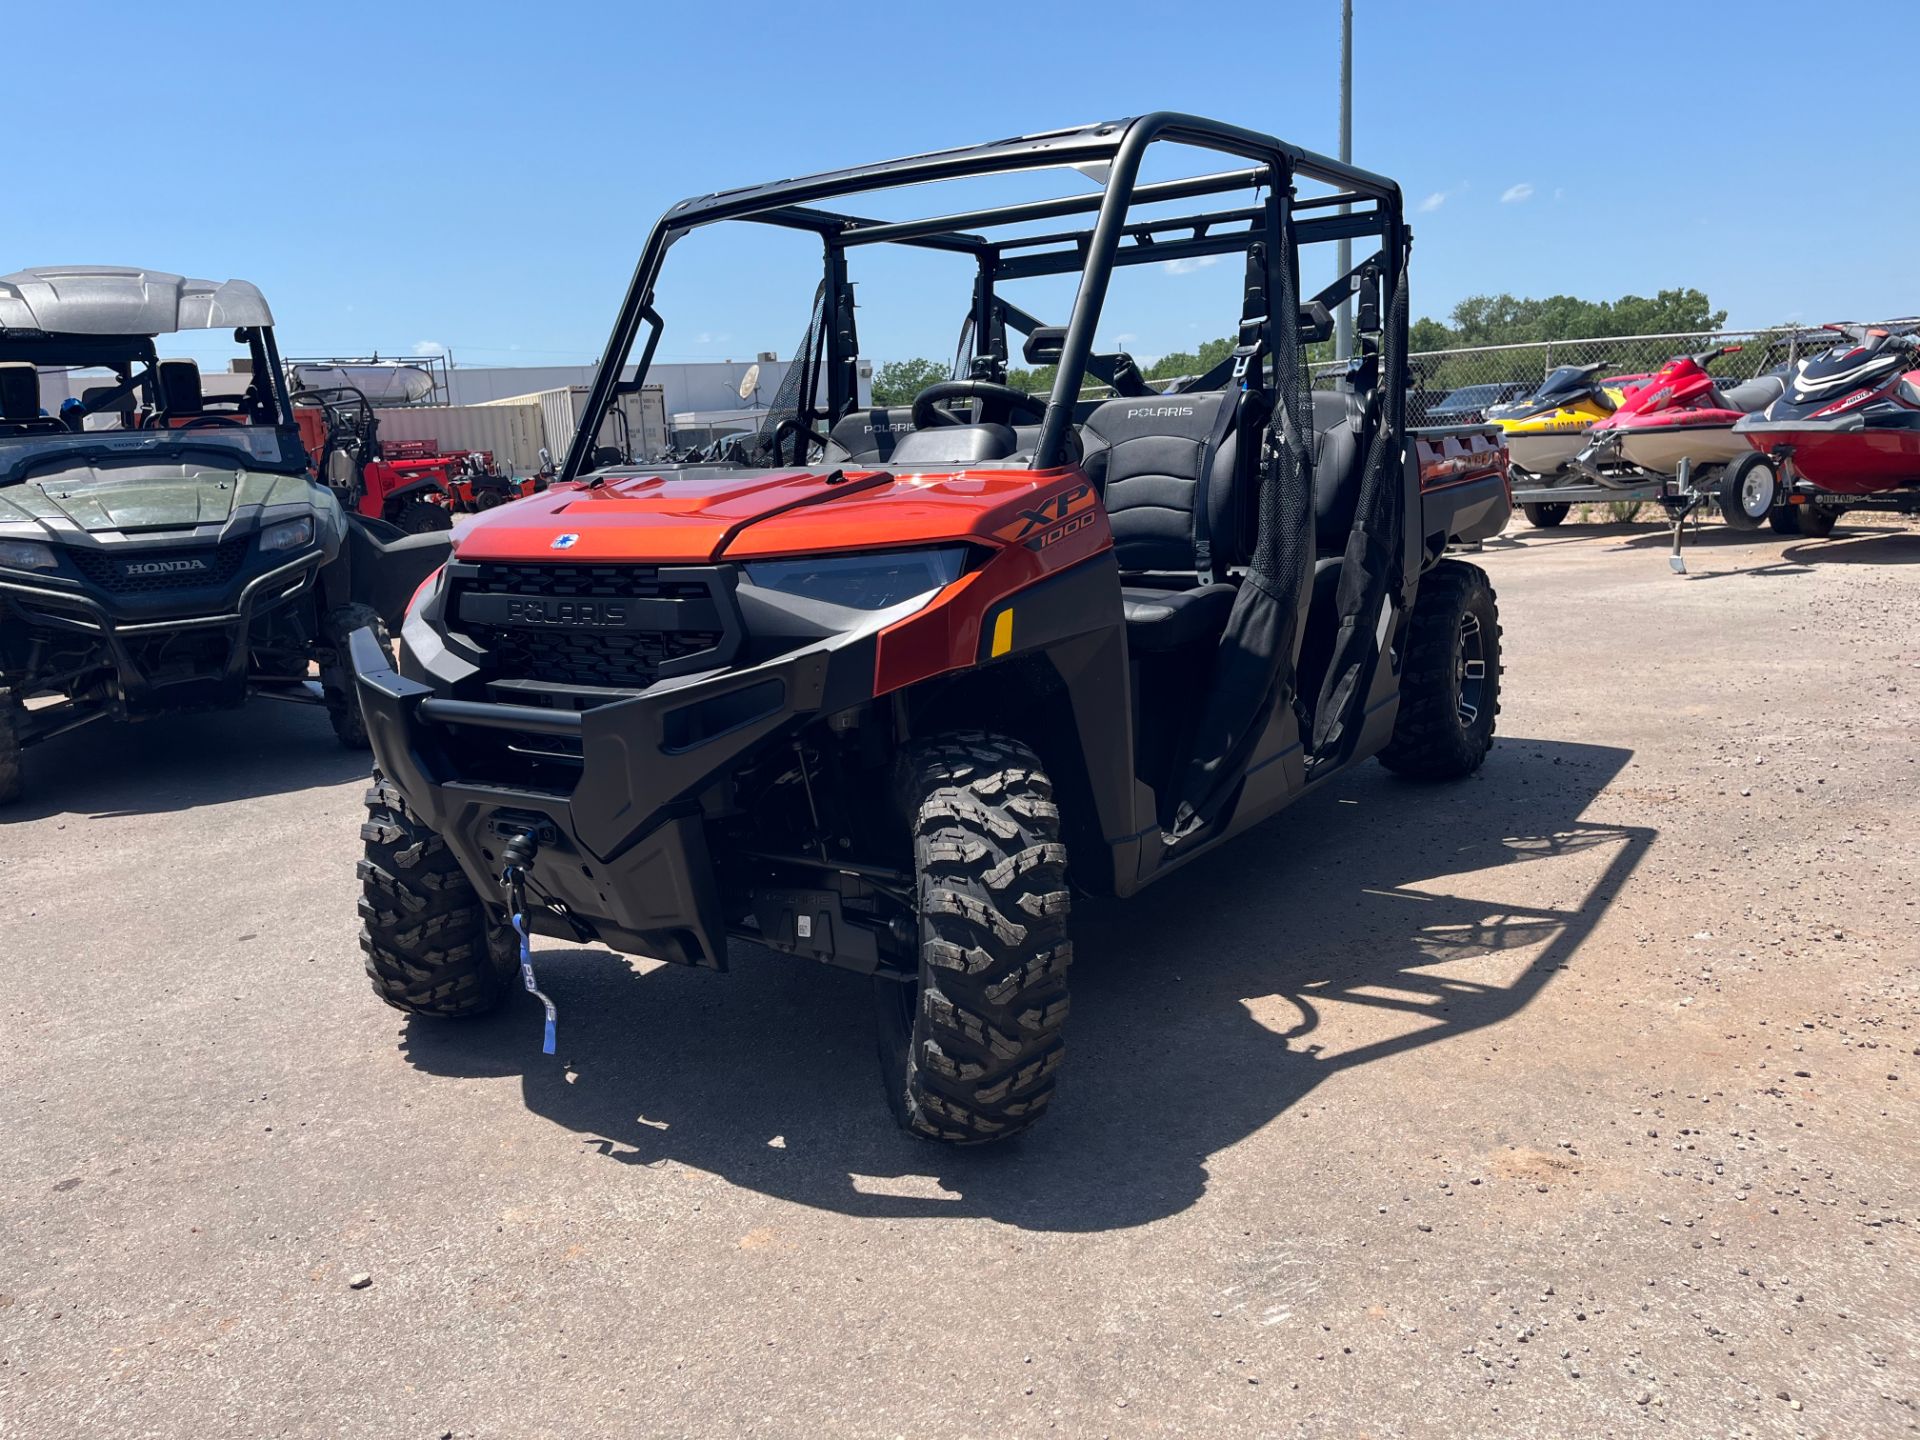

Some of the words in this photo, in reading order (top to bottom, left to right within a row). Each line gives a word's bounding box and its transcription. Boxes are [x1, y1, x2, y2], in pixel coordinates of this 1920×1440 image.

[1127, 406, 1193, 419] POLARIS
[864, 422, 918, 435] POLARIS
[1015, 484, 1089, 539] XP
[1041, 511, 1095, 548] 1000
[126, 559, 207, 575] HONDA
[507, 599, 627, 626] POLARIS
